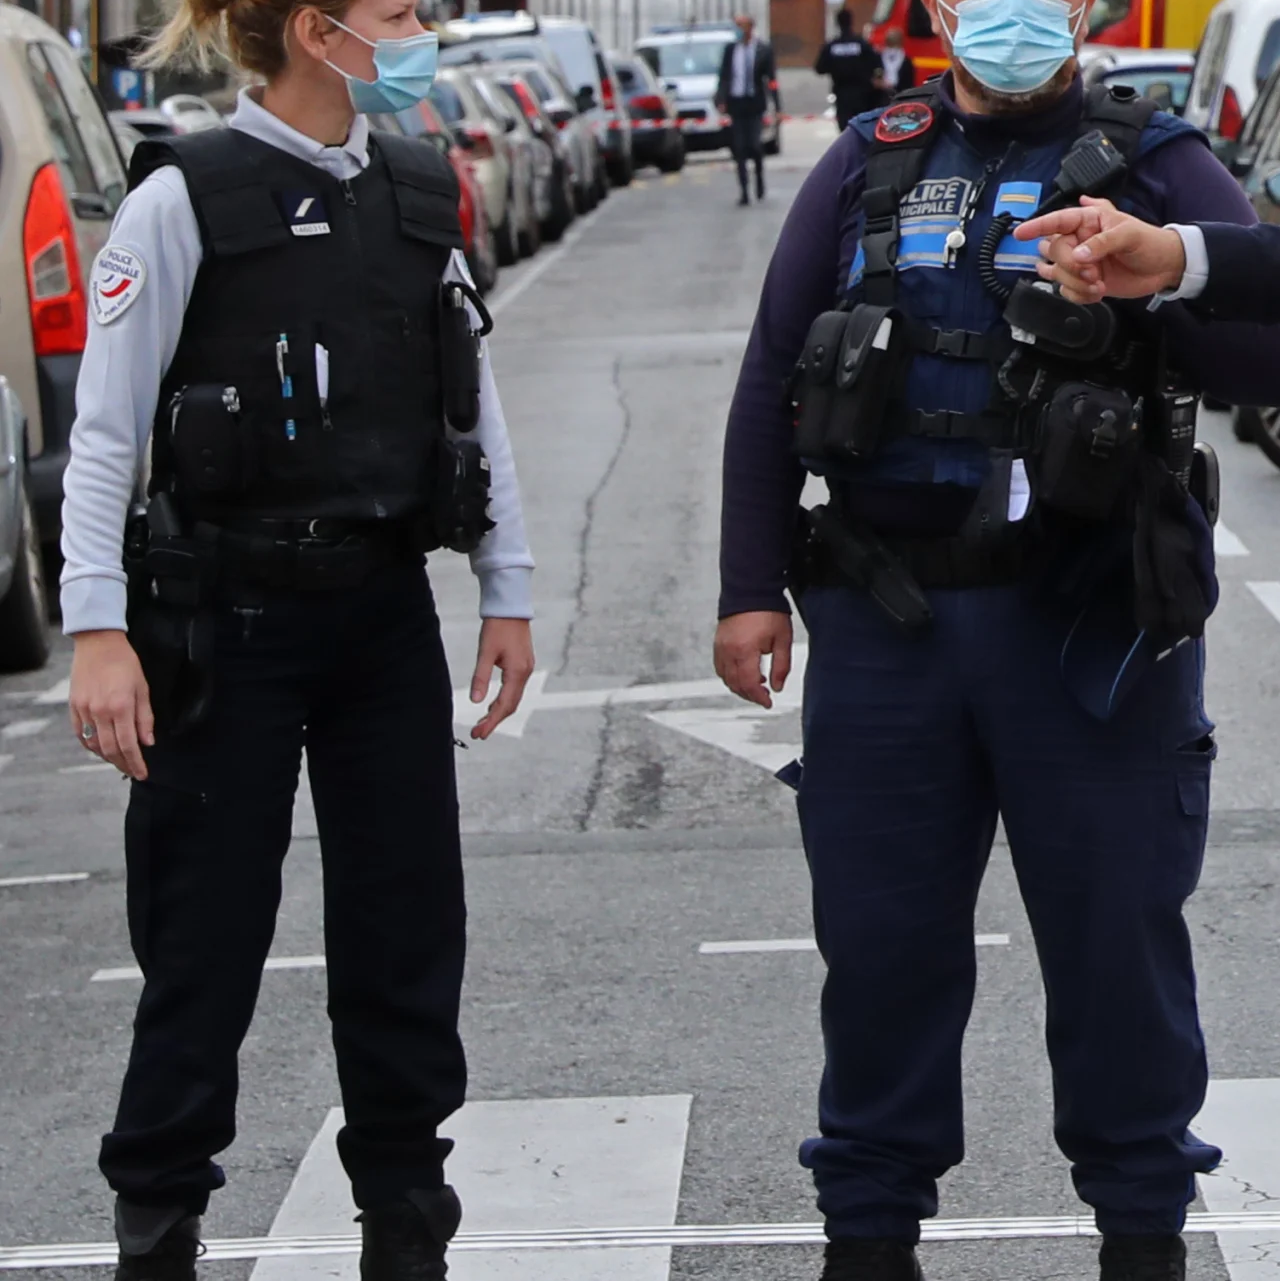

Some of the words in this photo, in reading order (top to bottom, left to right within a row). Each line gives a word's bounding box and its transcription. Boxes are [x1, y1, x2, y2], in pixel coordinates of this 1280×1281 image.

[900, 182, 960, 204] LICE
[108, 250, 132, 266] POLICE
[99, 259, 139, 279] NATIONALE
